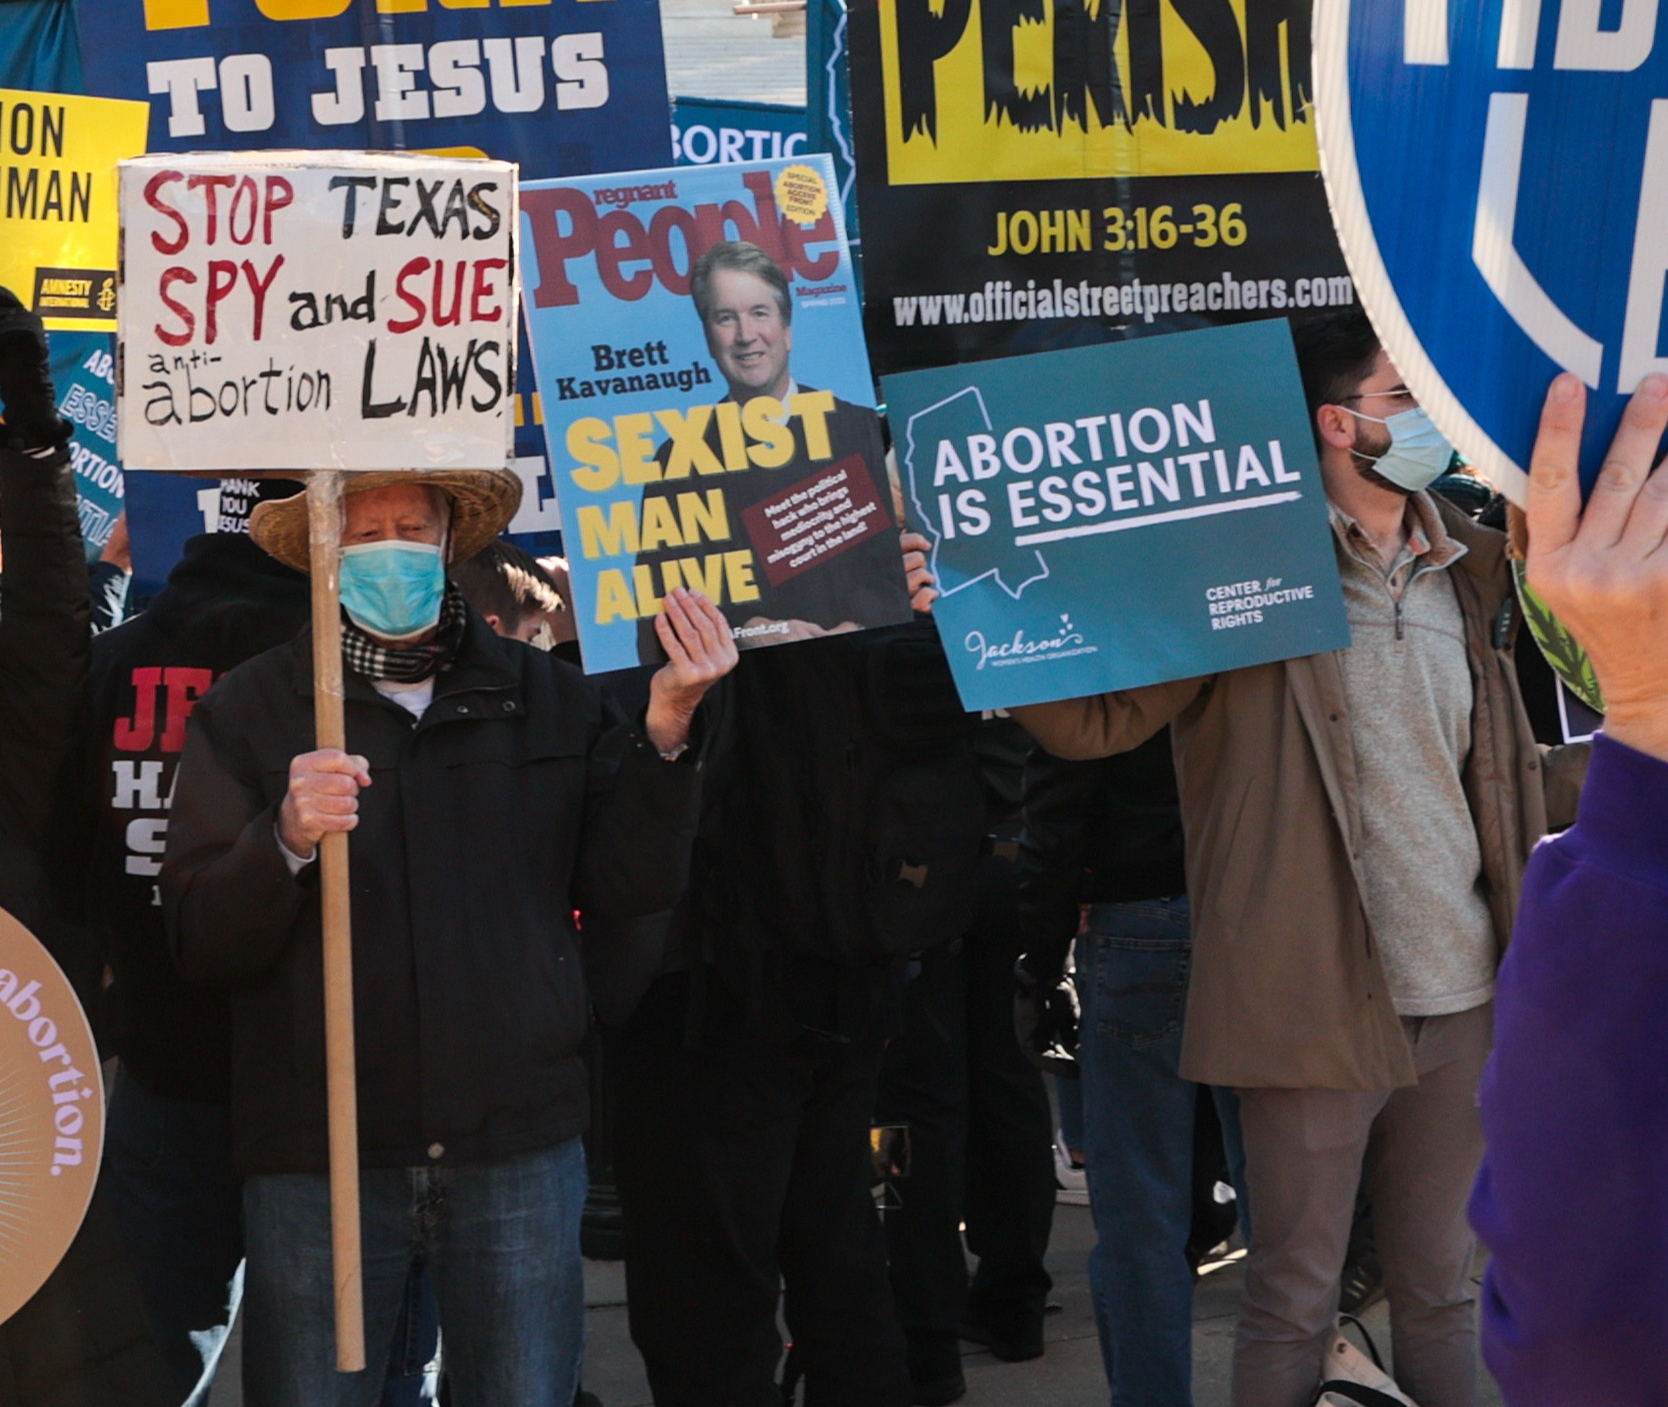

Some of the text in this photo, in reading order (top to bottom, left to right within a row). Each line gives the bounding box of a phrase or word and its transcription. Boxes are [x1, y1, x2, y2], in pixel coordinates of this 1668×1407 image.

[146, 32, 609, 138] TO JESUS
[142, 170, 503, 255] STOP TEXAS
[987, 203, 1248, 256] JOHN 3:16-36
[520, 171, 840, 310] People
[40, 278, 93, 296] AMNESTY
[152, 253, 509, 348] SPY and SUE
[893, 273, 1355, 326] www.officialstreetpreachers.com
[148, 349, 225, 374] anti-
[556, 361, 712, 400] Kavanaugh
[591, 340, 670, 372] Brett
[142, 371, 332, 428] abortion
[566, 390, 837, 493] SEXIST
[933, 398, 1216, 487] ABORTION
[936, 438, 1302, 540] IS ESSENTIAL
[577, 488, 732, 559] MAN
[595, 548, 761, 626] ALIVE
[1206, 575, 1285, 602] CENTER for
[1208, 585, 1315, 618] REPRODUCTIVE
[1211, 610, 1265, 631] RIGHTS
[964, 630, 1084, 671] Jackson
